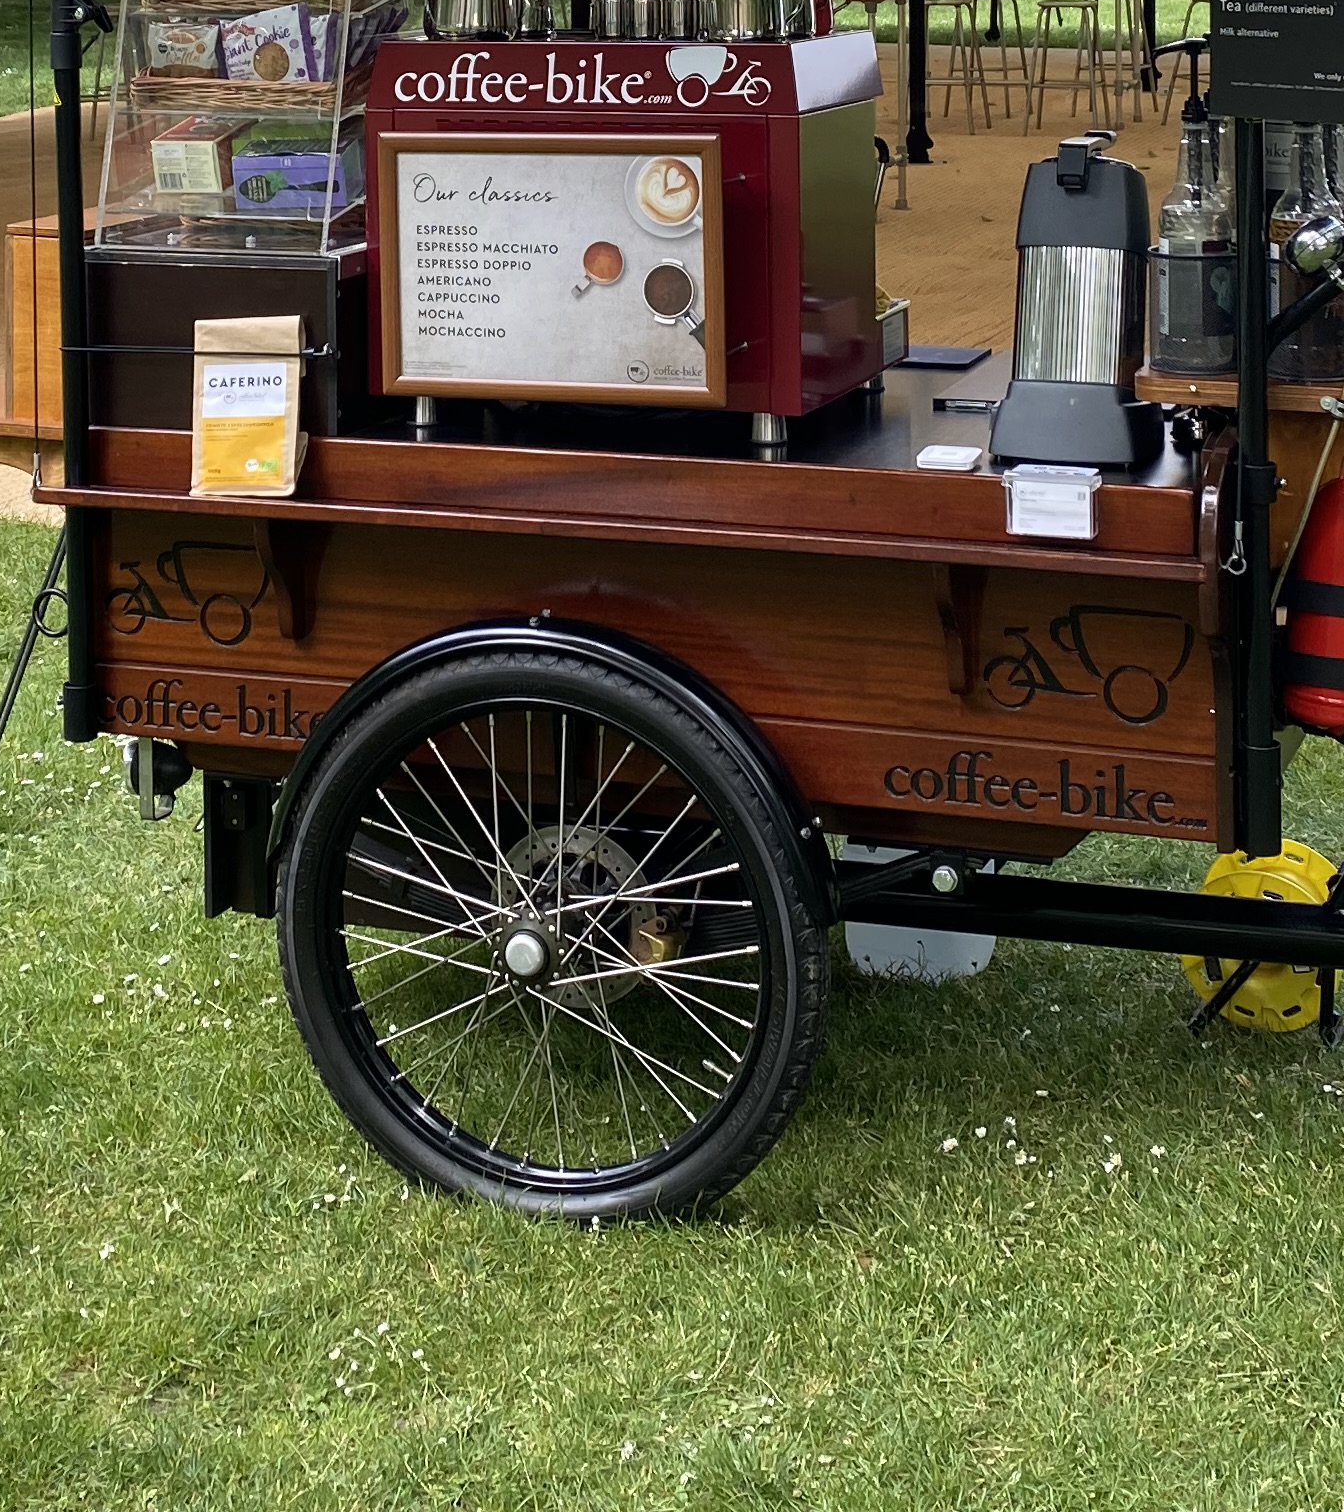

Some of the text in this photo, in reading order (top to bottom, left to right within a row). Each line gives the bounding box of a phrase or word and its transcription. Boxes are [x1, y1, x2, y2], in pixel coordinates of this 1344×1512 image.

[1219, 0, 1334, 16] Tea (different varieties)
[255, 26, 291, 49] Cookie
[1219, 28, 1279, 38] Milk alternative
[413, 172, 559, 205] Our classics
[416, 225, 478, 236] ESPRESSO
[417, 242, 558, 254] ESPRESSO MACCHIATO
[417, 259, 531, 271] ESPRESSO DOPPIO
[417, 276, 491, 287] AMERICANO
[418, 292, 500, 304] CAPPUCCINO
[418, 309, 465, 320] MOCHA
[418, 326, 506, 338] MOCHACCINO
[208, 376, 283, 388] CAFERINO
